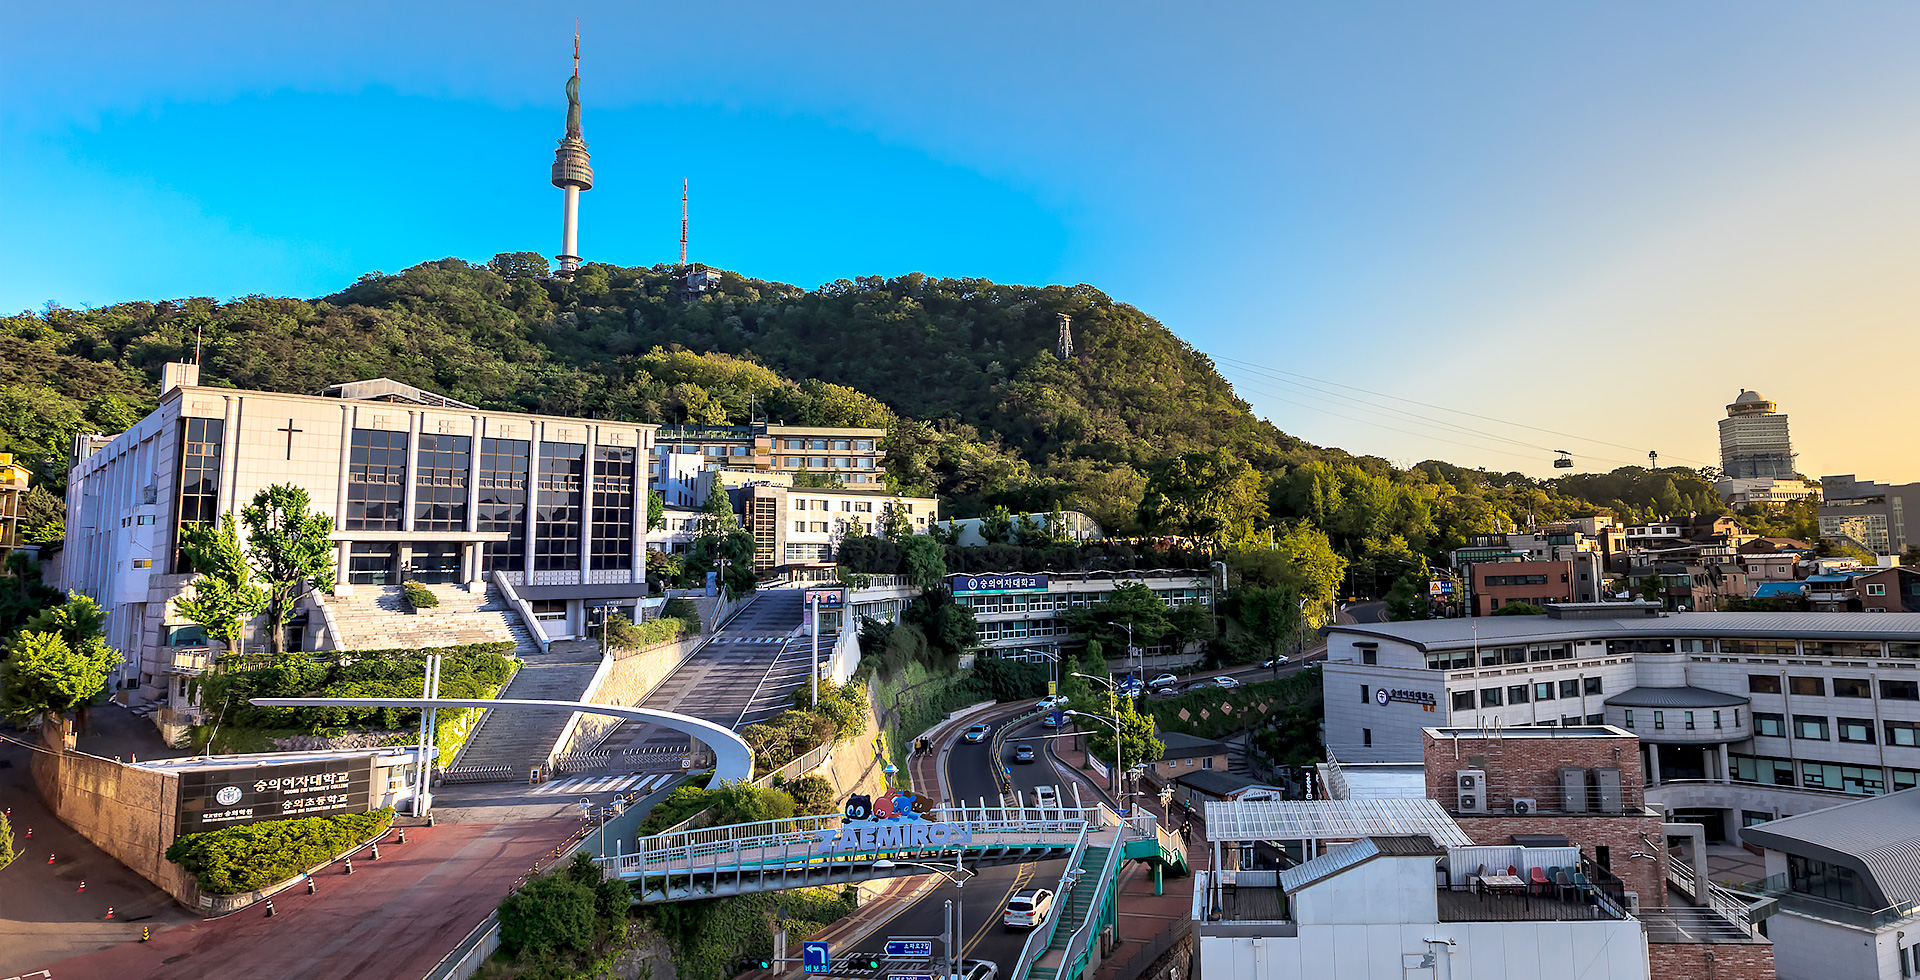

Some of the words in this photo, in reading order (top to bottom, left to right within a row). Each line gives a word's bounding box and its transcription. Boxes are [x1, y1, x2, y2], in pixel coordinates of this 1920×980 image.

[980, 578, 1036, 588] 숭의여자대학교
[253, 772, 350, 793] 숭의여자대학교
[281, 794, 348, 810] 숭의초등학교
[804, 964, 828, 973] 비보호
